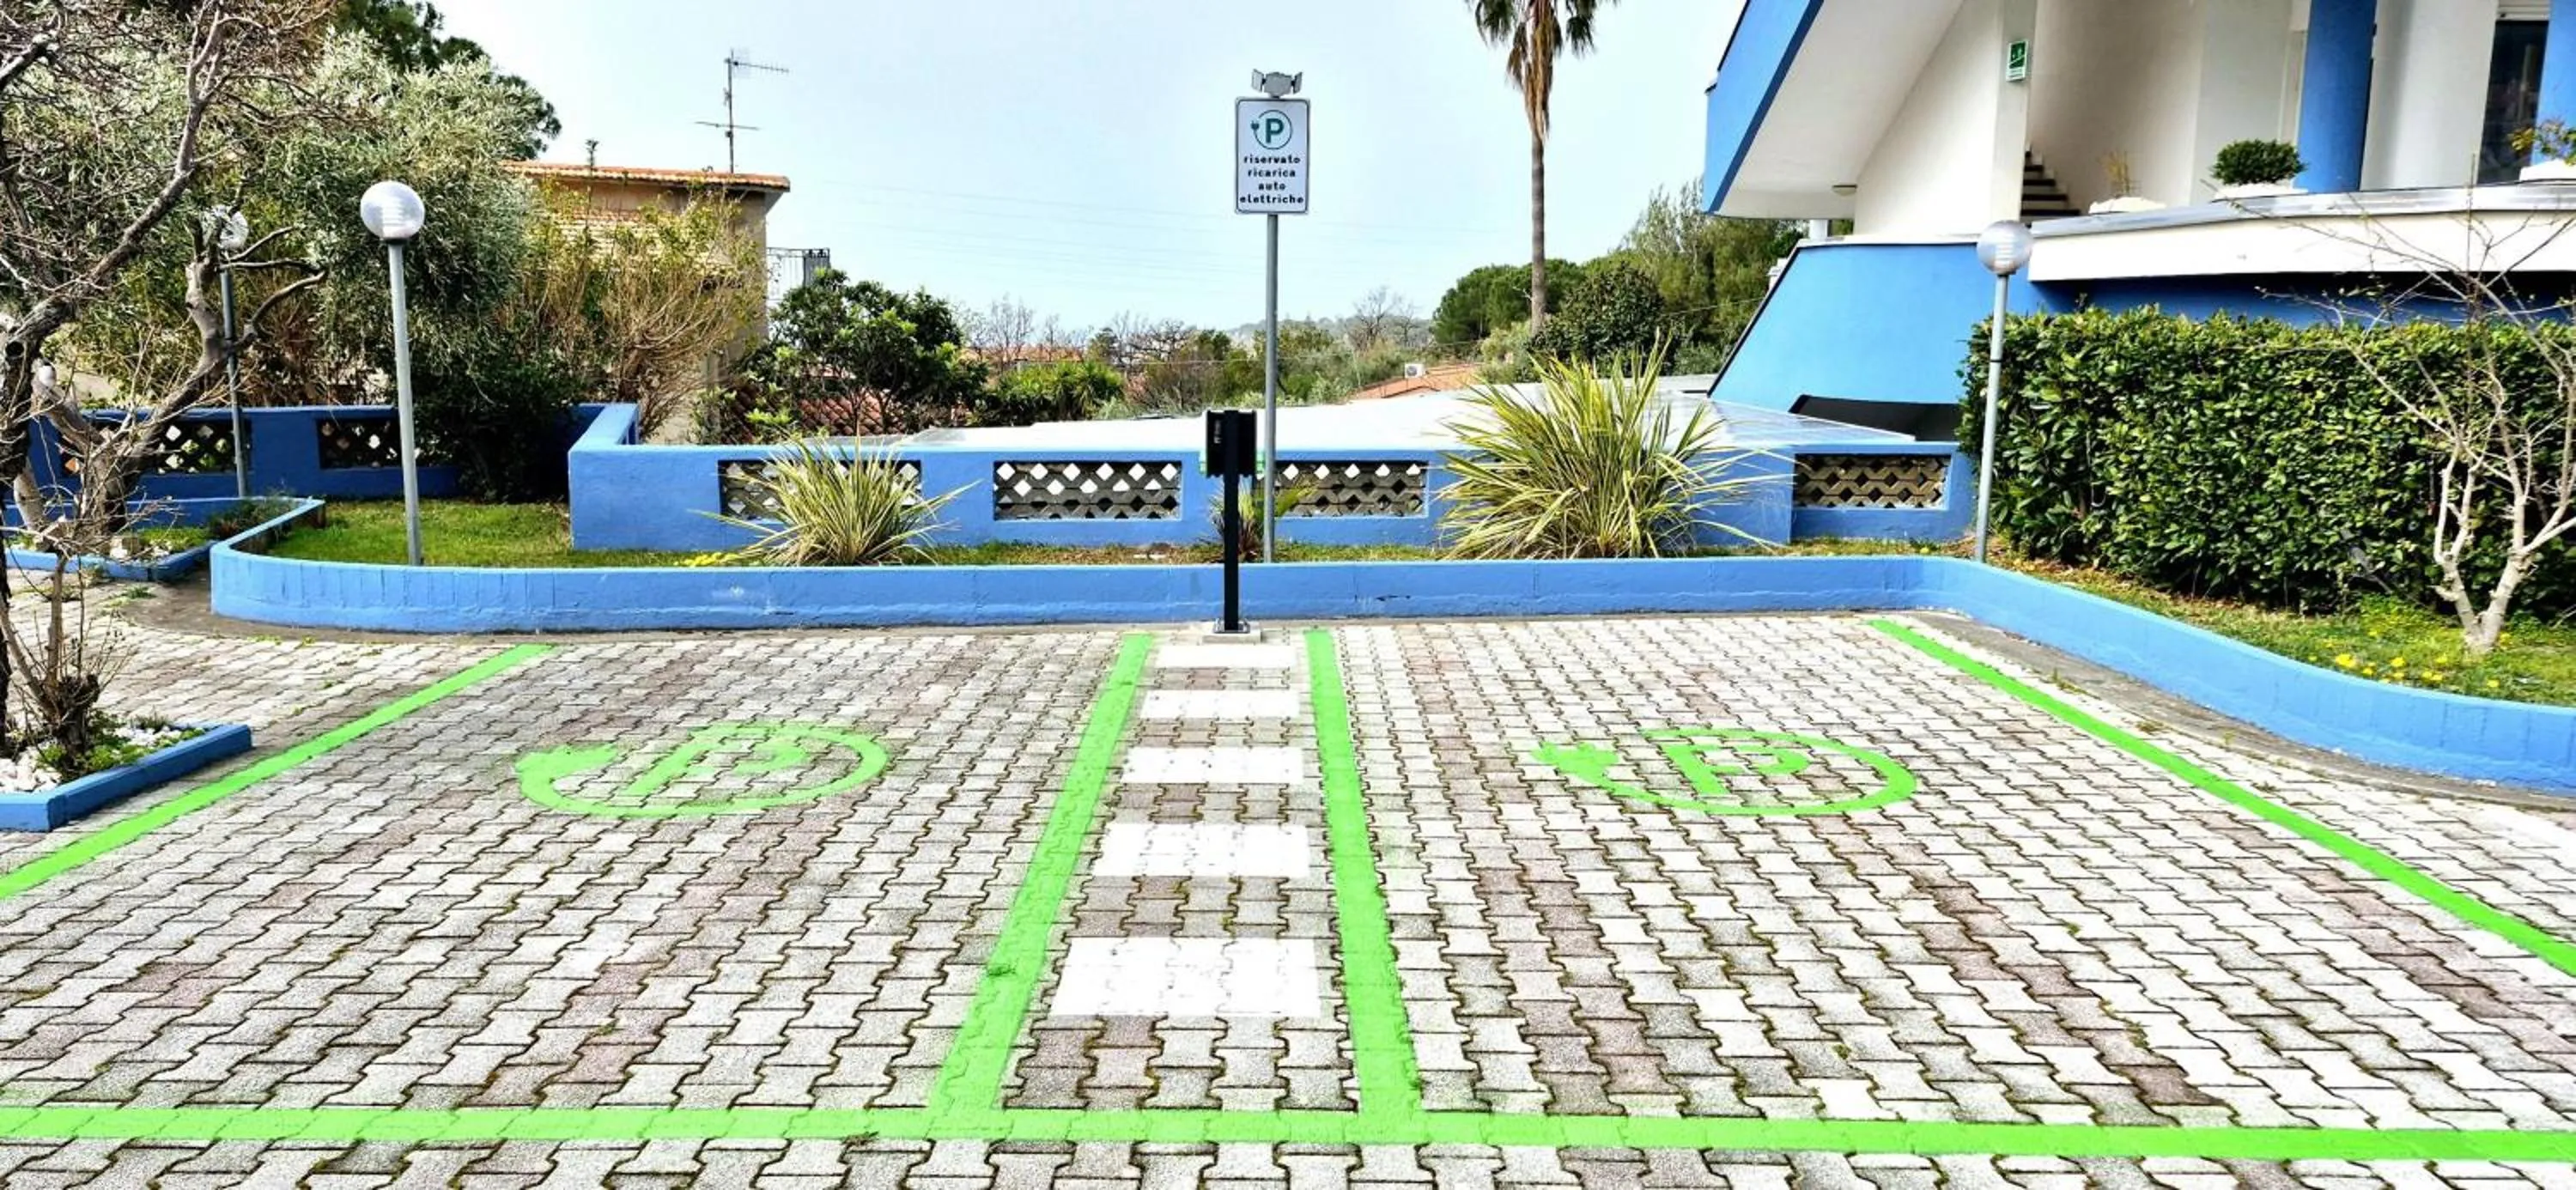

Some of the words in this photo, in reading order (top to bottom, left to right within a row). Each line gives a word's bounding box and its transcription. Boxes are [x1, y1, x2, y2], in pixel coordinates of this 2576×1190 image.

[1265, 118, 1285, 144] P
[1243, 154, 1301, 164] riservato
[1248, 167, 1296, 178] ricarica
[1258, 181, 1286, 191] auto
[1239, 193, 1304, 203] elettriche
[624, 737, 809, 795] P
[1662, 744, 1809, 796] P
